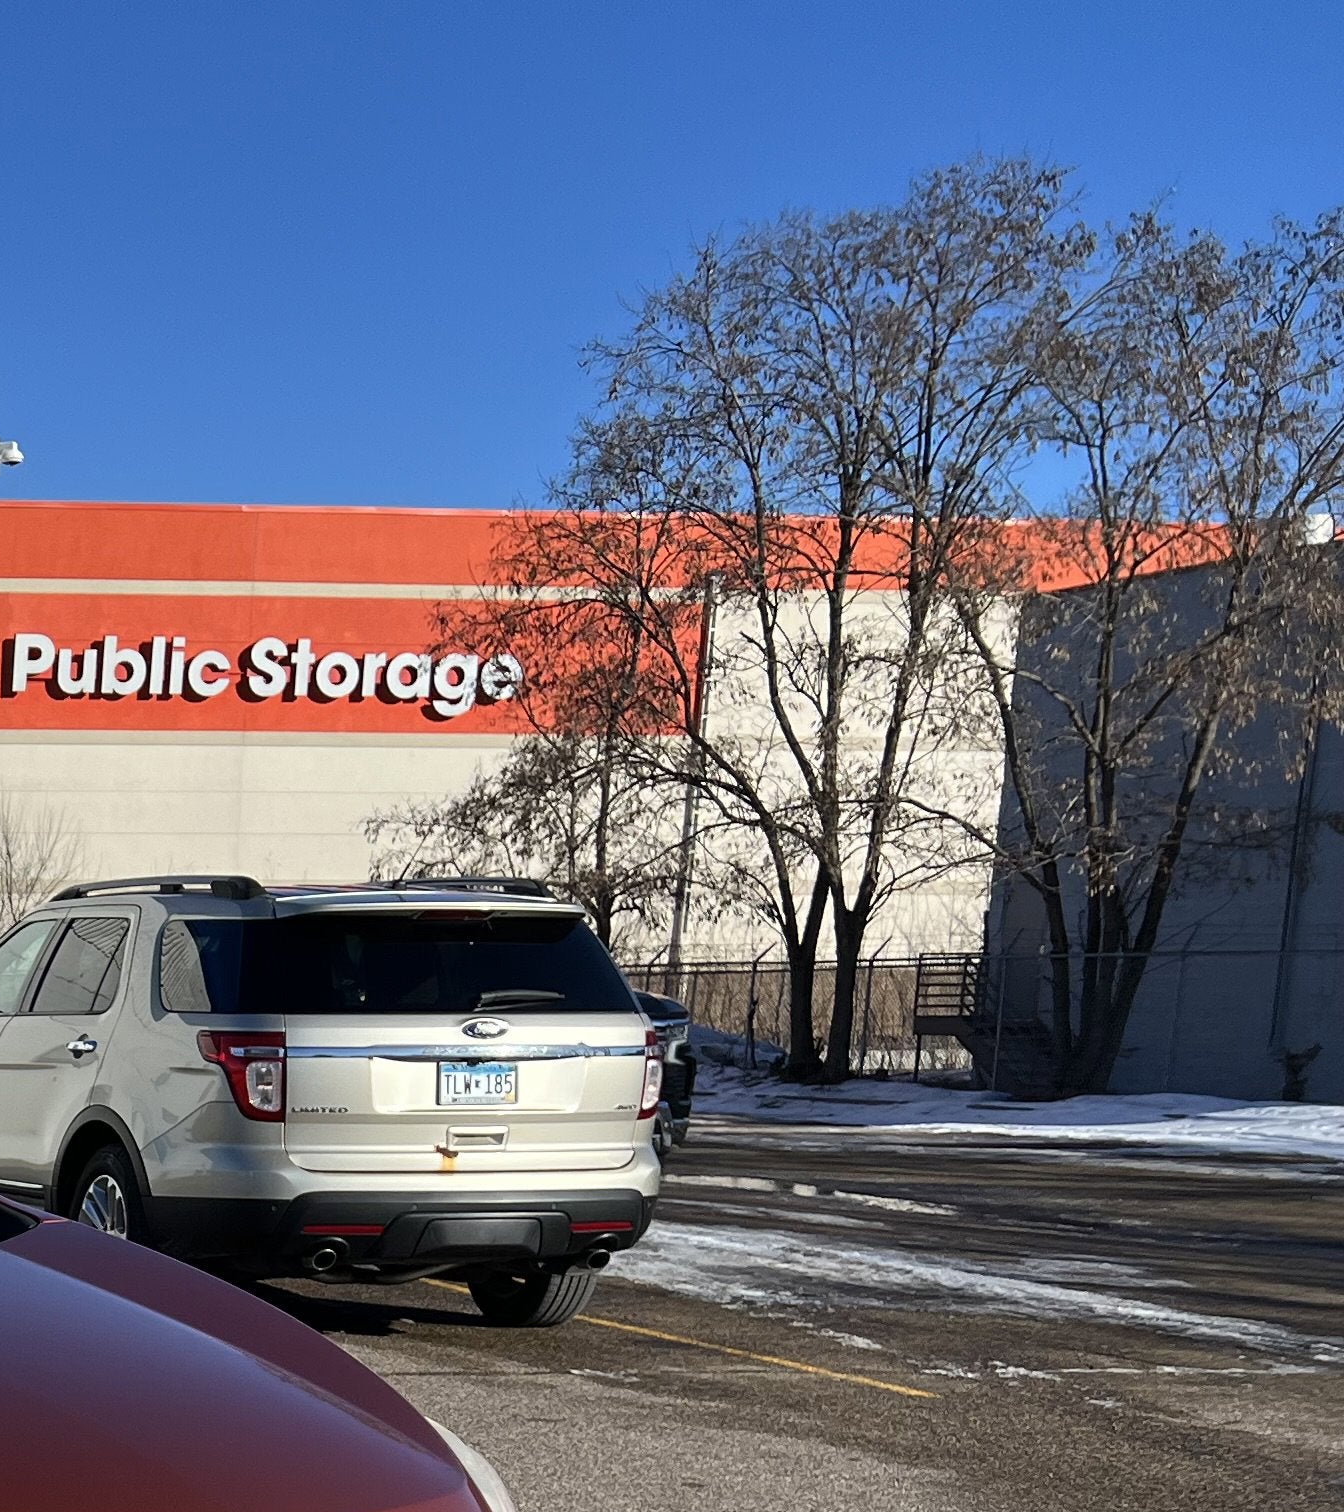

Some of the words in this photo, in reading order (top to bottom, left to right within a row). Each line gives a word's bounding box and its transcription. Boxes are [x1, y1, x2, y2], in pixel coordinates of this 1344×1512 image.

[13, 633, 231, 694] Public
[249, 637, 523, 717] Storage
[444, 1074, 472, 1094] TLW
[485, 1073, 513, 1094] 185
